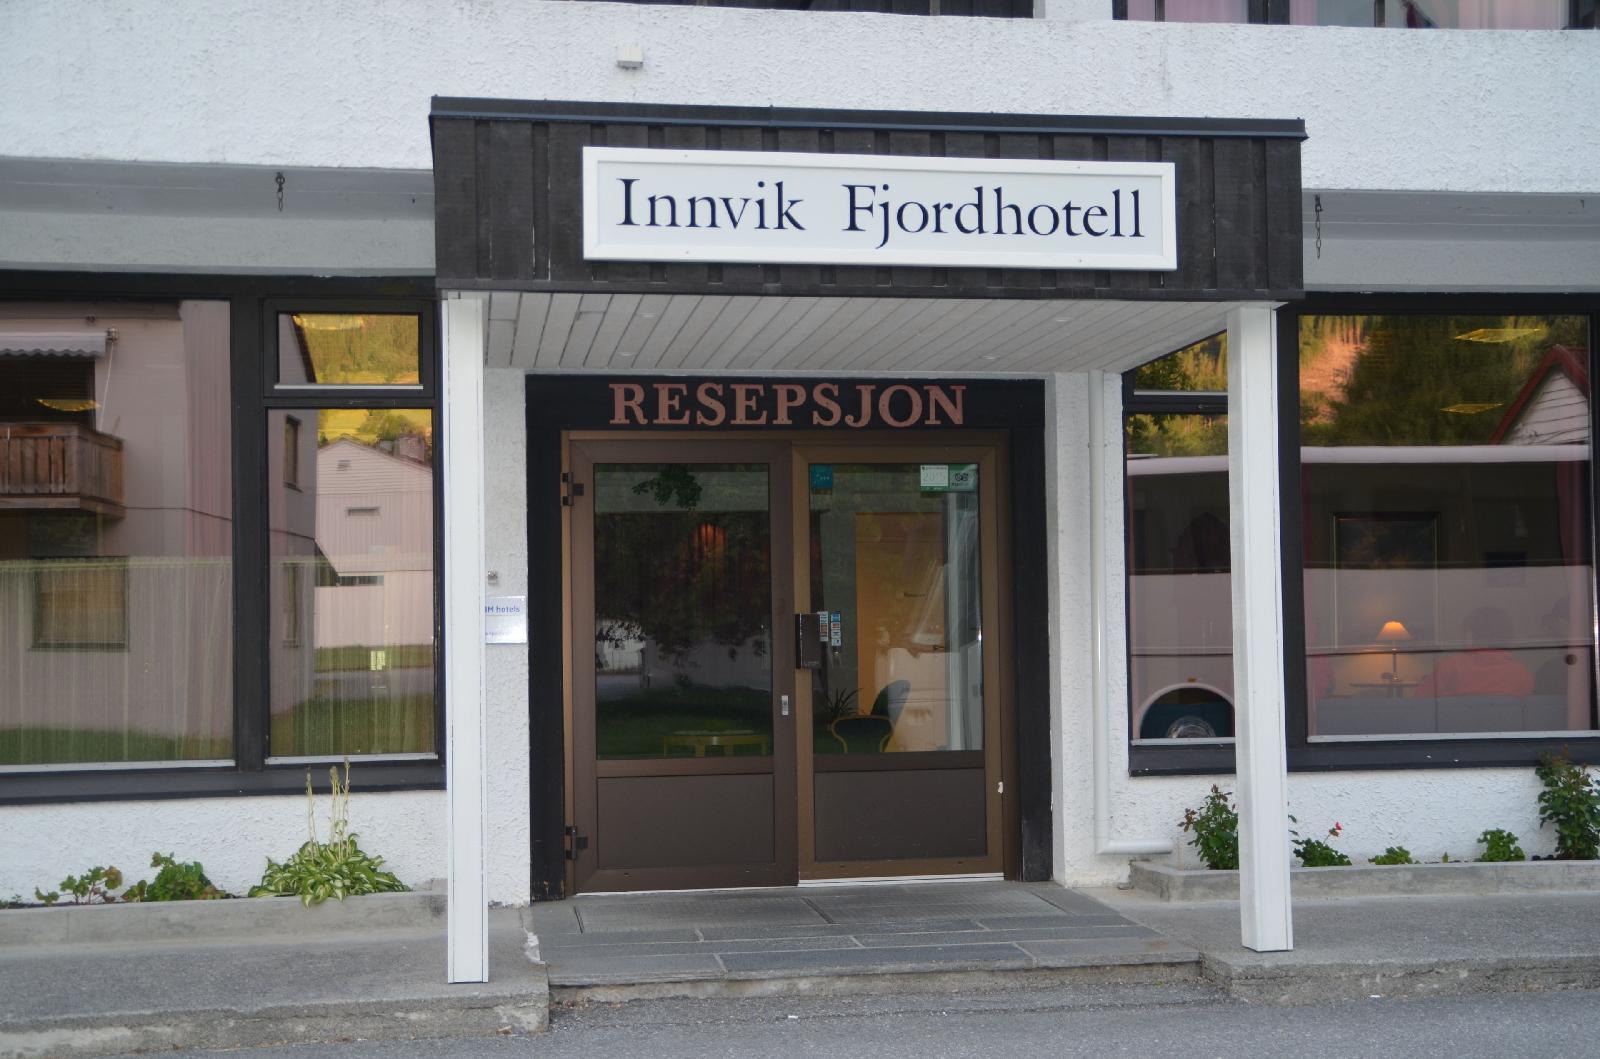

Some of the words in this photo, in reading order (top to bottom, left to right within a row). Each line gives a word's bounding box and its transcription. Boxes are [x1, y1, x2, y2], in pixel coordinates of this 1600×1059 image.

[616, 178, 805, 231] Innvik
[841, 184, 1145, 249] Fjordhotell
[609, 383, 965, 428] RESEPSJON
[496, 605, 520, 613] hotels
